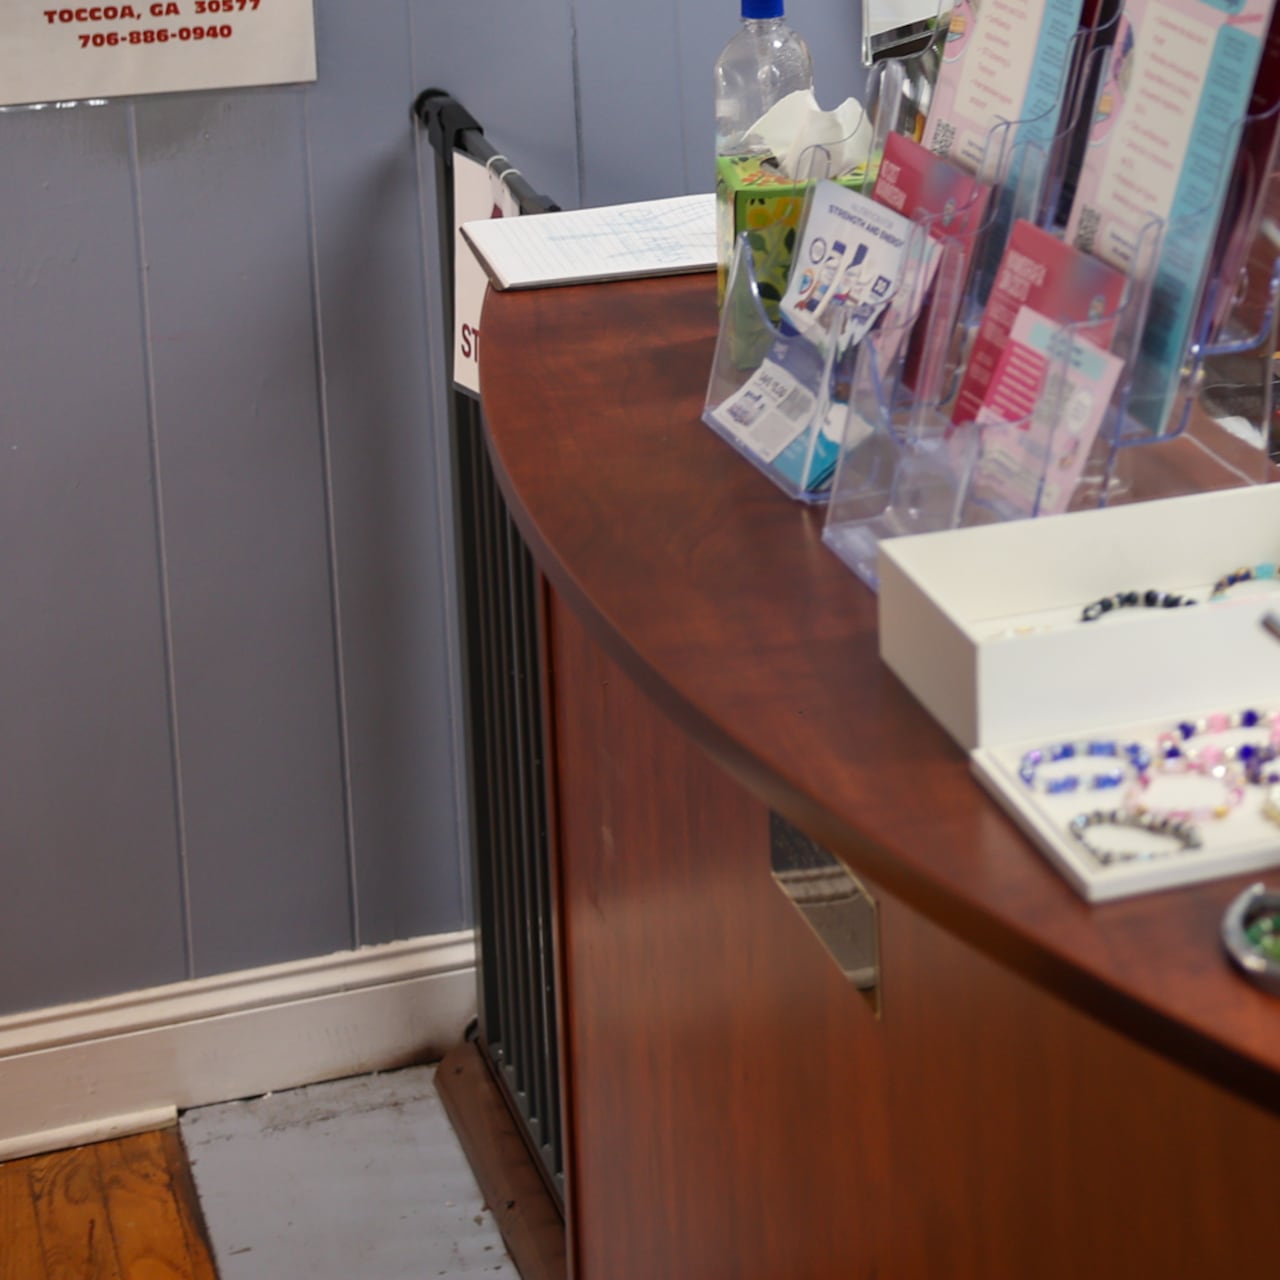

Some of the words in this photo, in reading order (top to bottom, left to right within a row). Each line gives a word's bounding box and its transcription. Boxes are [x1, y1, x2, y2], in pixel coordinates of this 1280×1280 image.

[44, 5, 142, 24] TOCCOA,
[150, 2, 180, 17] GA
[78, 24, 232, 48] 706-886-0940
